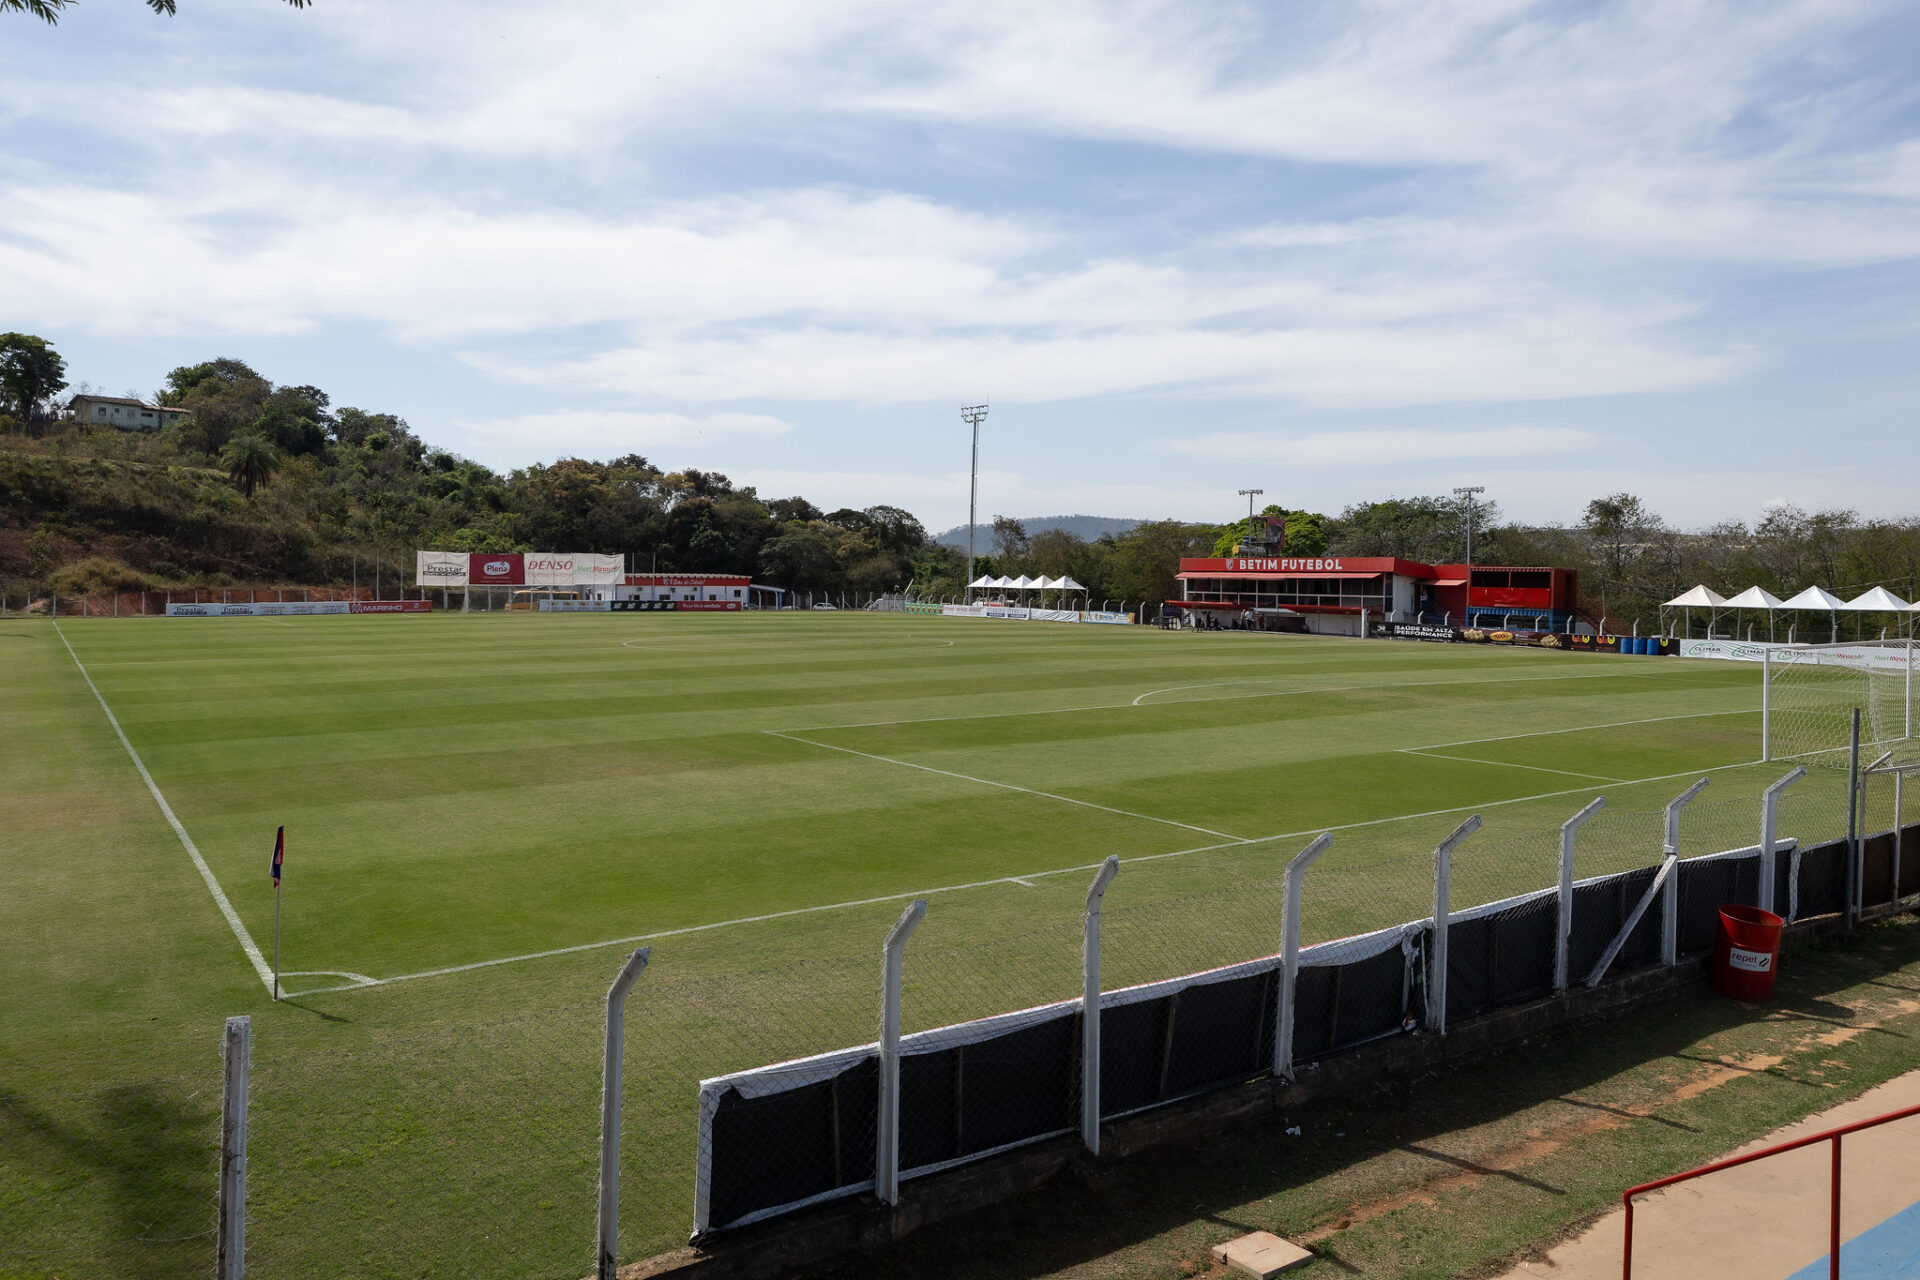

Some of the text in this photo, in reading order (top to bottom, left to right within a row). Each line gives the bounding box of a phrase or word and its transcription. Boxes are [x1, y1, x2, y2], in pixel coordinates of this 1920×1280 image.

[487, 564, 508, 572] Plena
[528, 560, 573, 570] DENSO
[1239, 559, 1343, 571] BETIM FUTEBOL
[1396, 630, 1453, 638] PERFORMANCE
[1732, 953, 1757, 963] repel
